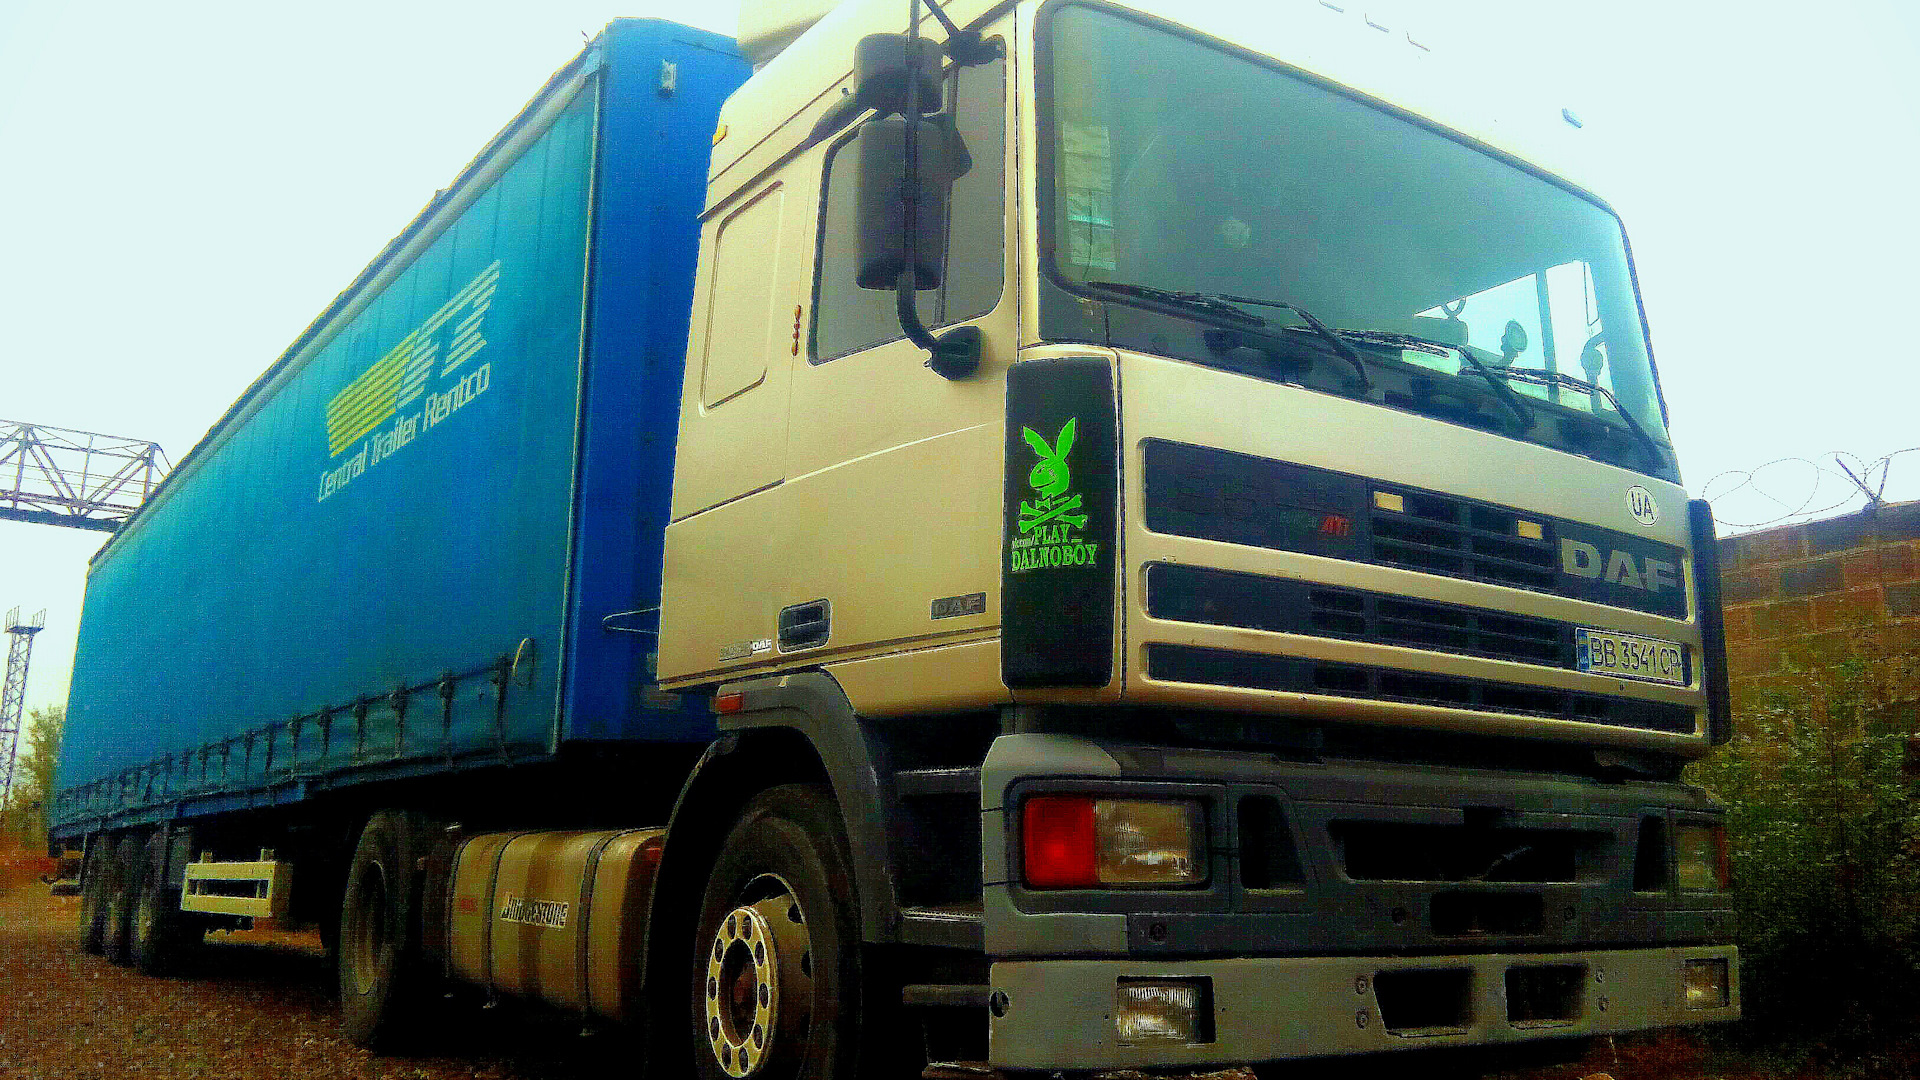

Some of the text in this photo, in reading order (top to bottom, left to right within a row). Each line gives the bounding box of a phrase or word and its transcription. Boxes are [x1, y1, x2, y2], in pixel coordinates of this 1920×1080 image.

[318, 363, 491, 502] Central Trailer Rentco
[1630, 491, 1656, 521] UA
[1011, 544, 1098, 572] DALNOBOY
[1561, 538, 1677, 593] DAF
[932, 595, 982, 617] DAF
[752, 639, 772, 652] DAF
[1590, 637, 1616, 668] BB
[1620, 640, 1657, 674] 3541
[1660, 646, 1681, 676] CP
